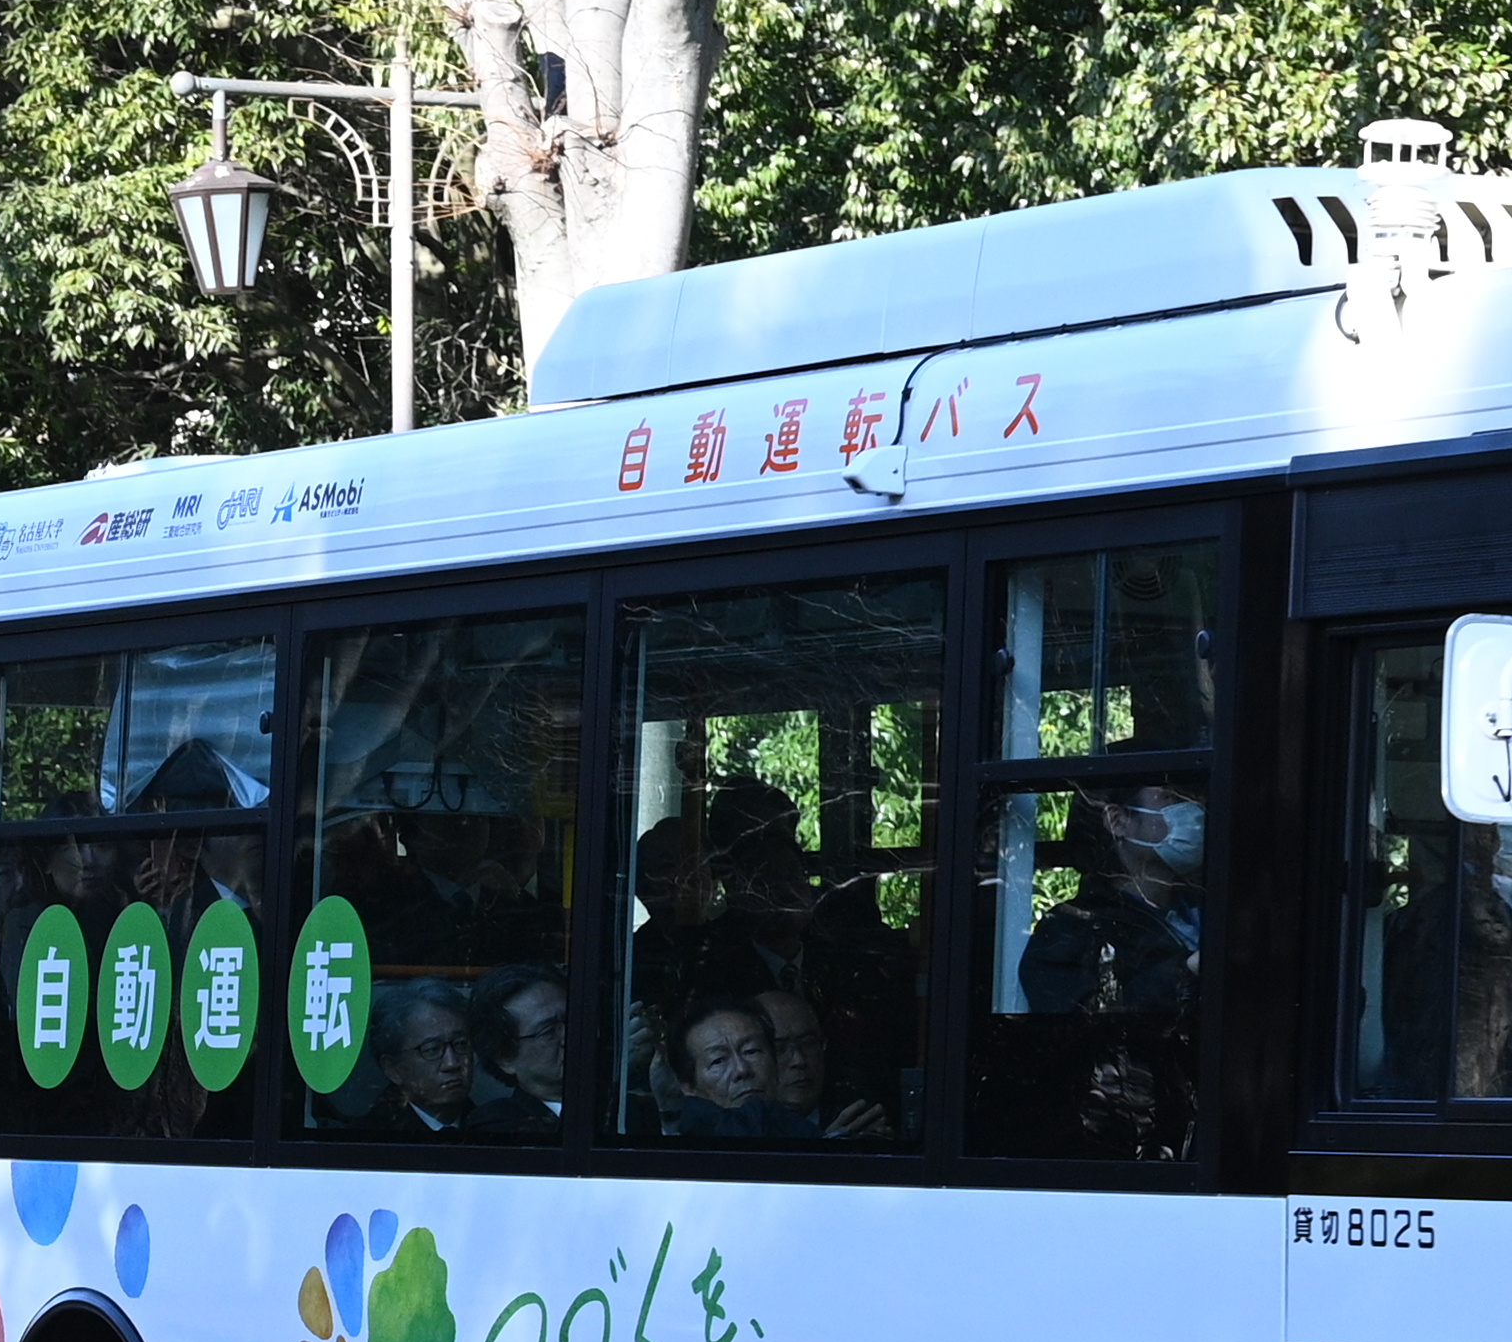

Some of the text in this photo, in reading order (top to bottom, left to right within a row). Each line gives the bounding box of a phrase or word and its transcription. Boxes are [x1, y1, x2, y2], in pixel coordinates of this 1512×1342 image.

[618, 373, 1042, 492] 自動運転バス
[172, 494, 203, 520] MRI
[298, 477, 366, 513] ASMobi
[17, 518, 64, 544] 名古屋大学
[106, 508, 155, 541] 産総研
[33, 940, 354, 1052] 自動運転
